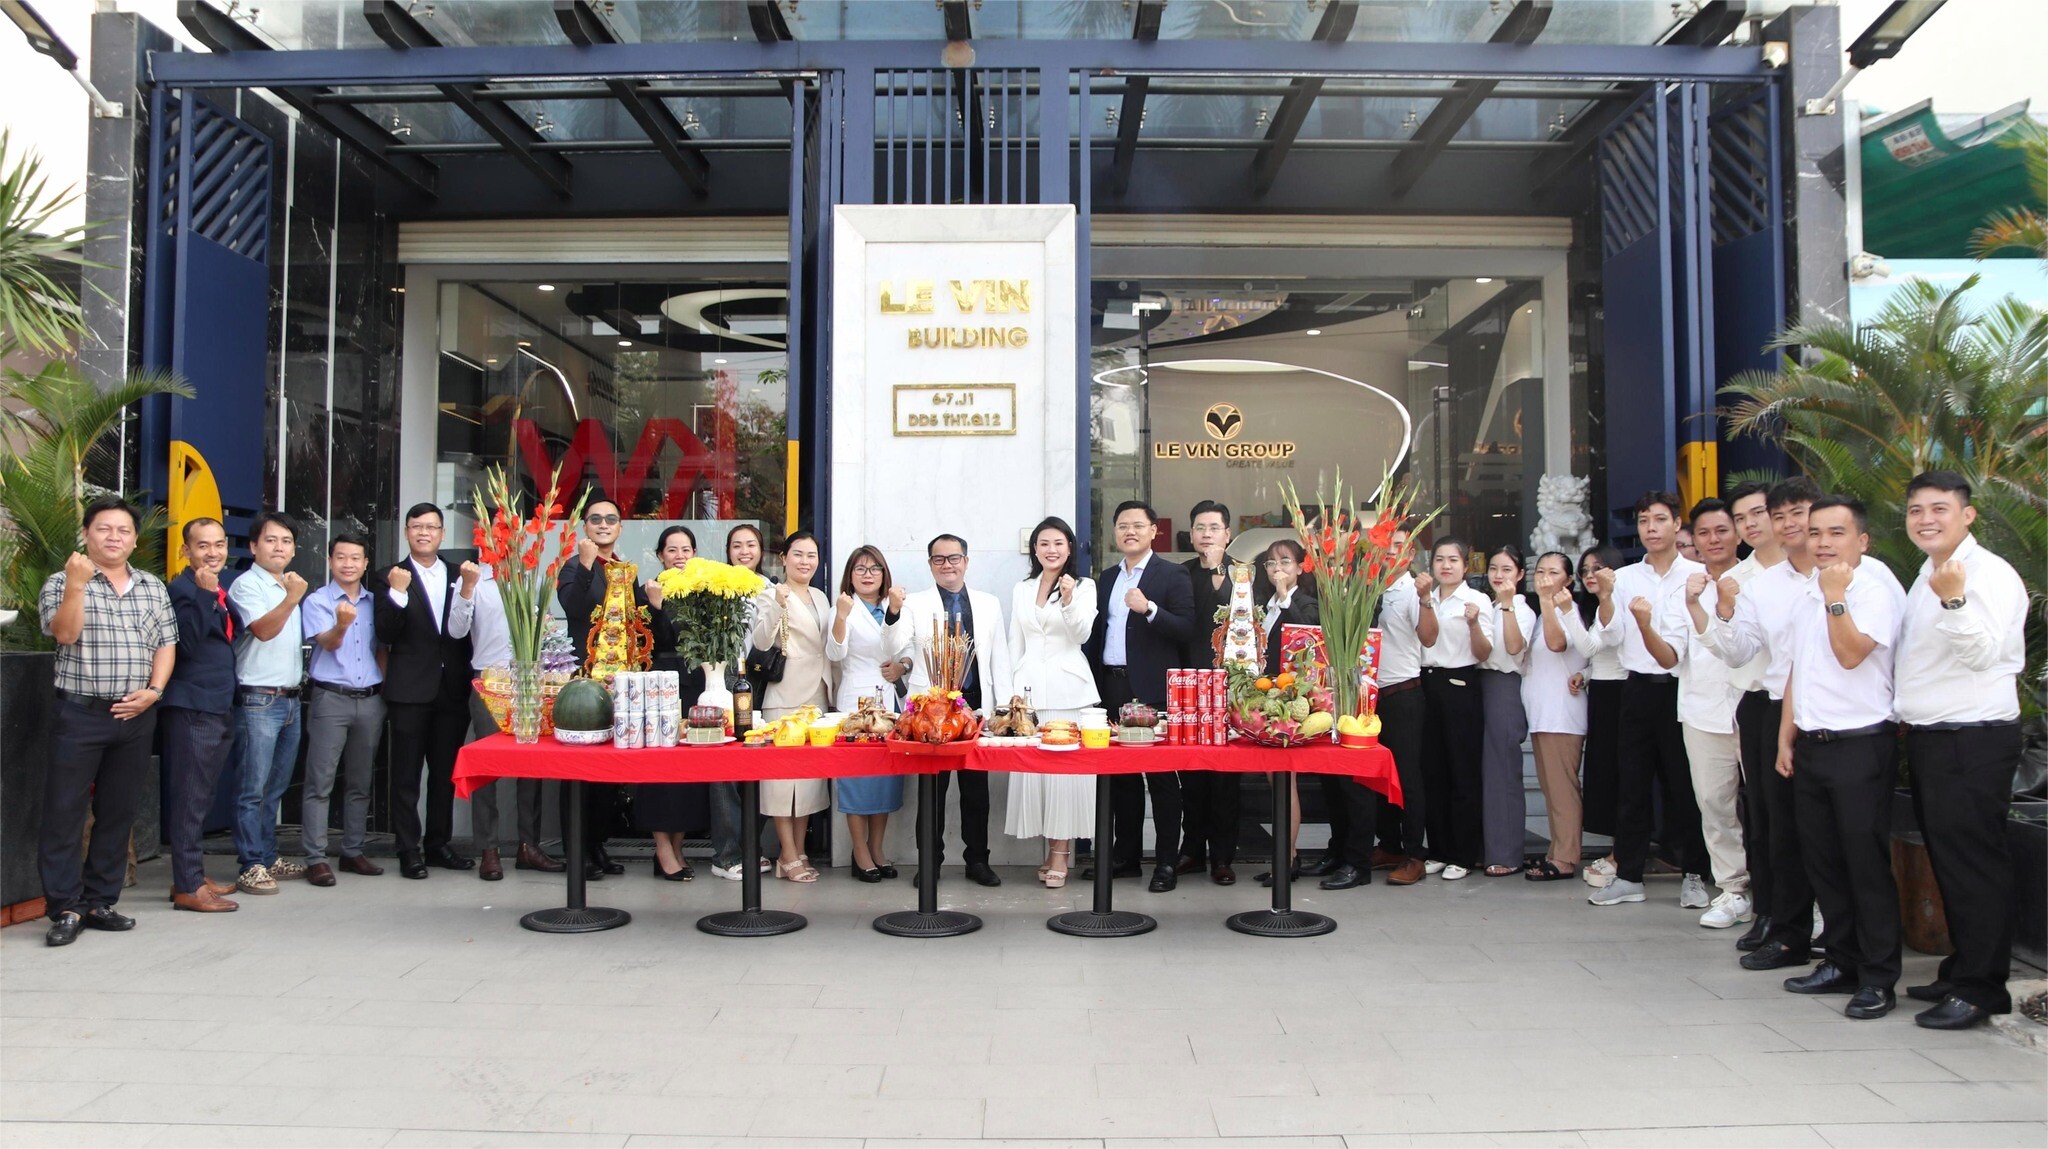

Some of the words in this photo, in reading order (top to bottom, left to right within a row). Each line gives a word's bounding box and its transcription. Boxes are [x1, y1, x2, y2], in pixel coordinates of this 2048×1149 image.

[879, 279, 935, 315] LE
[949, 279, 1031, 315] VIN
[907, 326, 1029, 349] BUILDING
[1155, 442, 1181, 458] LE
[1185, 442, 1220, 458] VIN
[1225, 442, 1295, 458] GROUP
[1225, 460, 1263, 469] CREATE
[1265, 460, 1295, 469] VALUE
